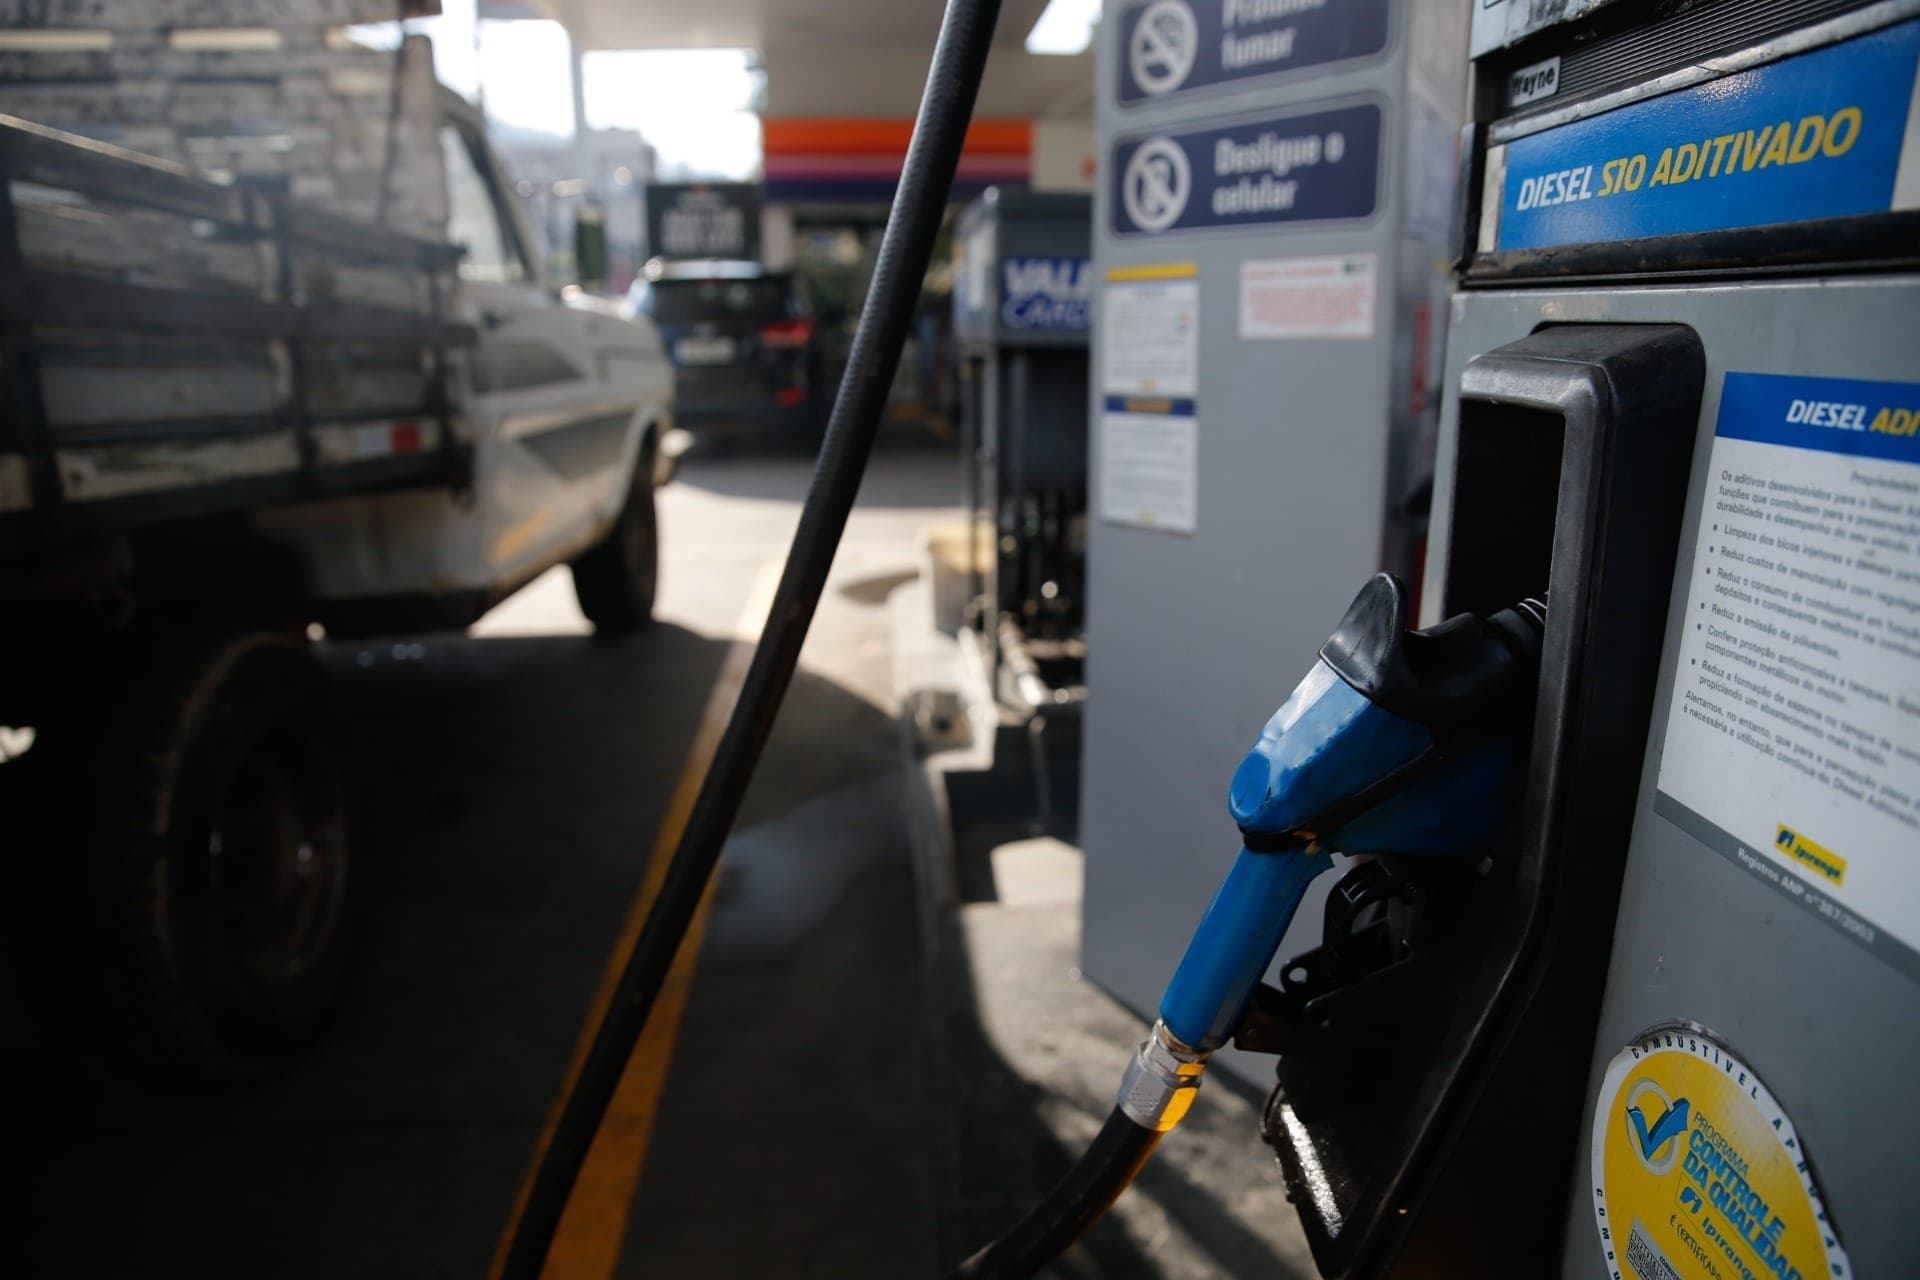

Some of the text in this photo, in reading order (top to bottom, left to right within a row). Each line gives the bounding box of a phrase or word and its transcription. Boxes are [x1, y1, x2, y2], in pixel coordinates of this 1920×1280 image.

[1214, 131, 1346, 177] Desligue o
[1516, 106, 1863, 211] DIESEL S10 ADITIVADO
[1212, 175, 1297, 216] celular
[1786, 399, 1867, 431] DIESEL
[1721, 469, 1732, 481] Os
[1733, 473, 1765, 488] aditivos
[1716, 500, 1763, 519] durabilidade
[1765, 513, 1771, 521] e
[1719, 484, 1749, 500] funções
[1751, 494, 1767, 504] que
[1769, 497, 1819, 514] contribuem
[1724, 524, 1757, 541] Limpeza
[1758, 534, 1774, 546] dos
[1776, 537, 1800, 552] bicos
[1720, 545, 1744, 561] Reduz
[1746, 555, 1774, 570] custos
[1776, 562, 1787, 574] de
[1714, 583, 1752, 603] depósitos
[1717, 567, 1741, 584] Reduz
[1742, 577, 1748, 586] o
[1750, 580, 1788, 598] consumo
[1711, 603, 1734, 620] Reduz
[1736, 614, 1742, 623] a
[1743, 617, 1777, 635] emissão
[1779, 629, 1790, 640] de
[1707, 624, 1738, 645] Confere
[1738, 639, 1775, 659] proteção
[1701, 659, 1724, 677] Reduz
[1726, 672, 1731, 681] a
[1733, 673, 1771, 698] formação
[1773, 692, 1784, 704] de
[1705, 641, 1756, 667] componentes
[1759, 663, 1799, 685] metálicos
[1698, 675, 1742, 701] propiciando
[1744, 697, 1758, 708] um
[1683, 703, 1688, 713] é
[1689, 708, 1727, 733] necessária
[1729, 728, 1735, 736] a
[1736, 732, 1774, 756] utilização
[1685, 690, 1723, 716] Alertamos,
[1726, 711, 1737, 722] no
[1775, 734, 1791, 748] que
[1631, 1035, 1758, 1099] COMBUSTÍVEL
[1693, 1111, 1749, 1177] PROGRAMA
[1682, 1150, 1709, 1191] DA
[1689, 1129, 1786, 1244] CONTROLE
